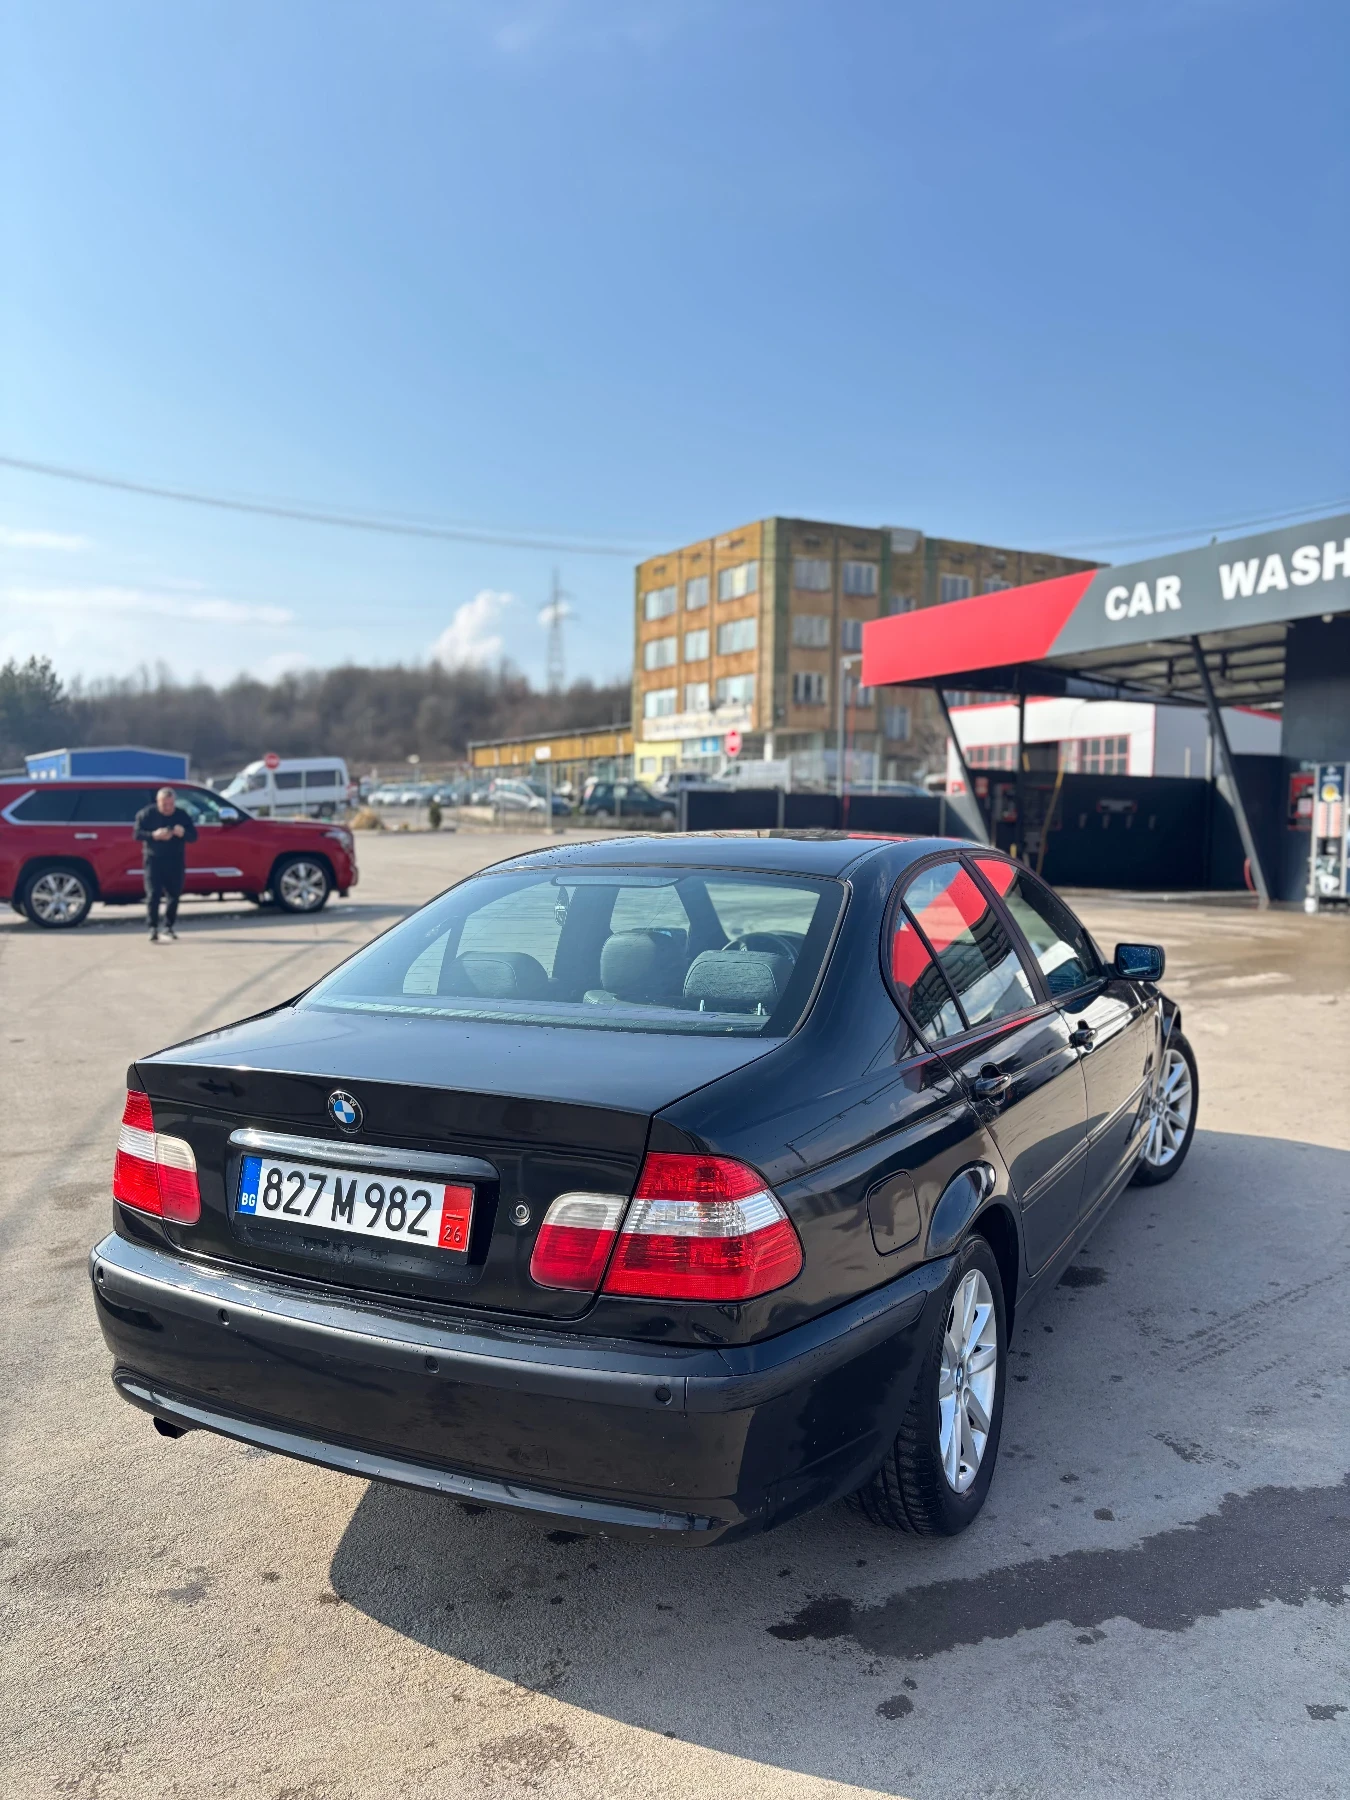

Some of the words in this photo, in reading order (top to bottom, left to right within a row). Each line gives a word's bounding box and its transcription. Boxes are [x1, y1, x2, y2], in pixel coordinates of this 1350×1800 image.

[1104, 575, 1182, 621] CAR
[1219, 537, 1350, 600] WASH
[241, 1192, 256, 1207] BG
[262, 1167, 328, 1217] 827
[330, 1176, 358, 1225] M
[364, 1182, 433, 1237] 982
[443, 1224, 461, 1244] 26
